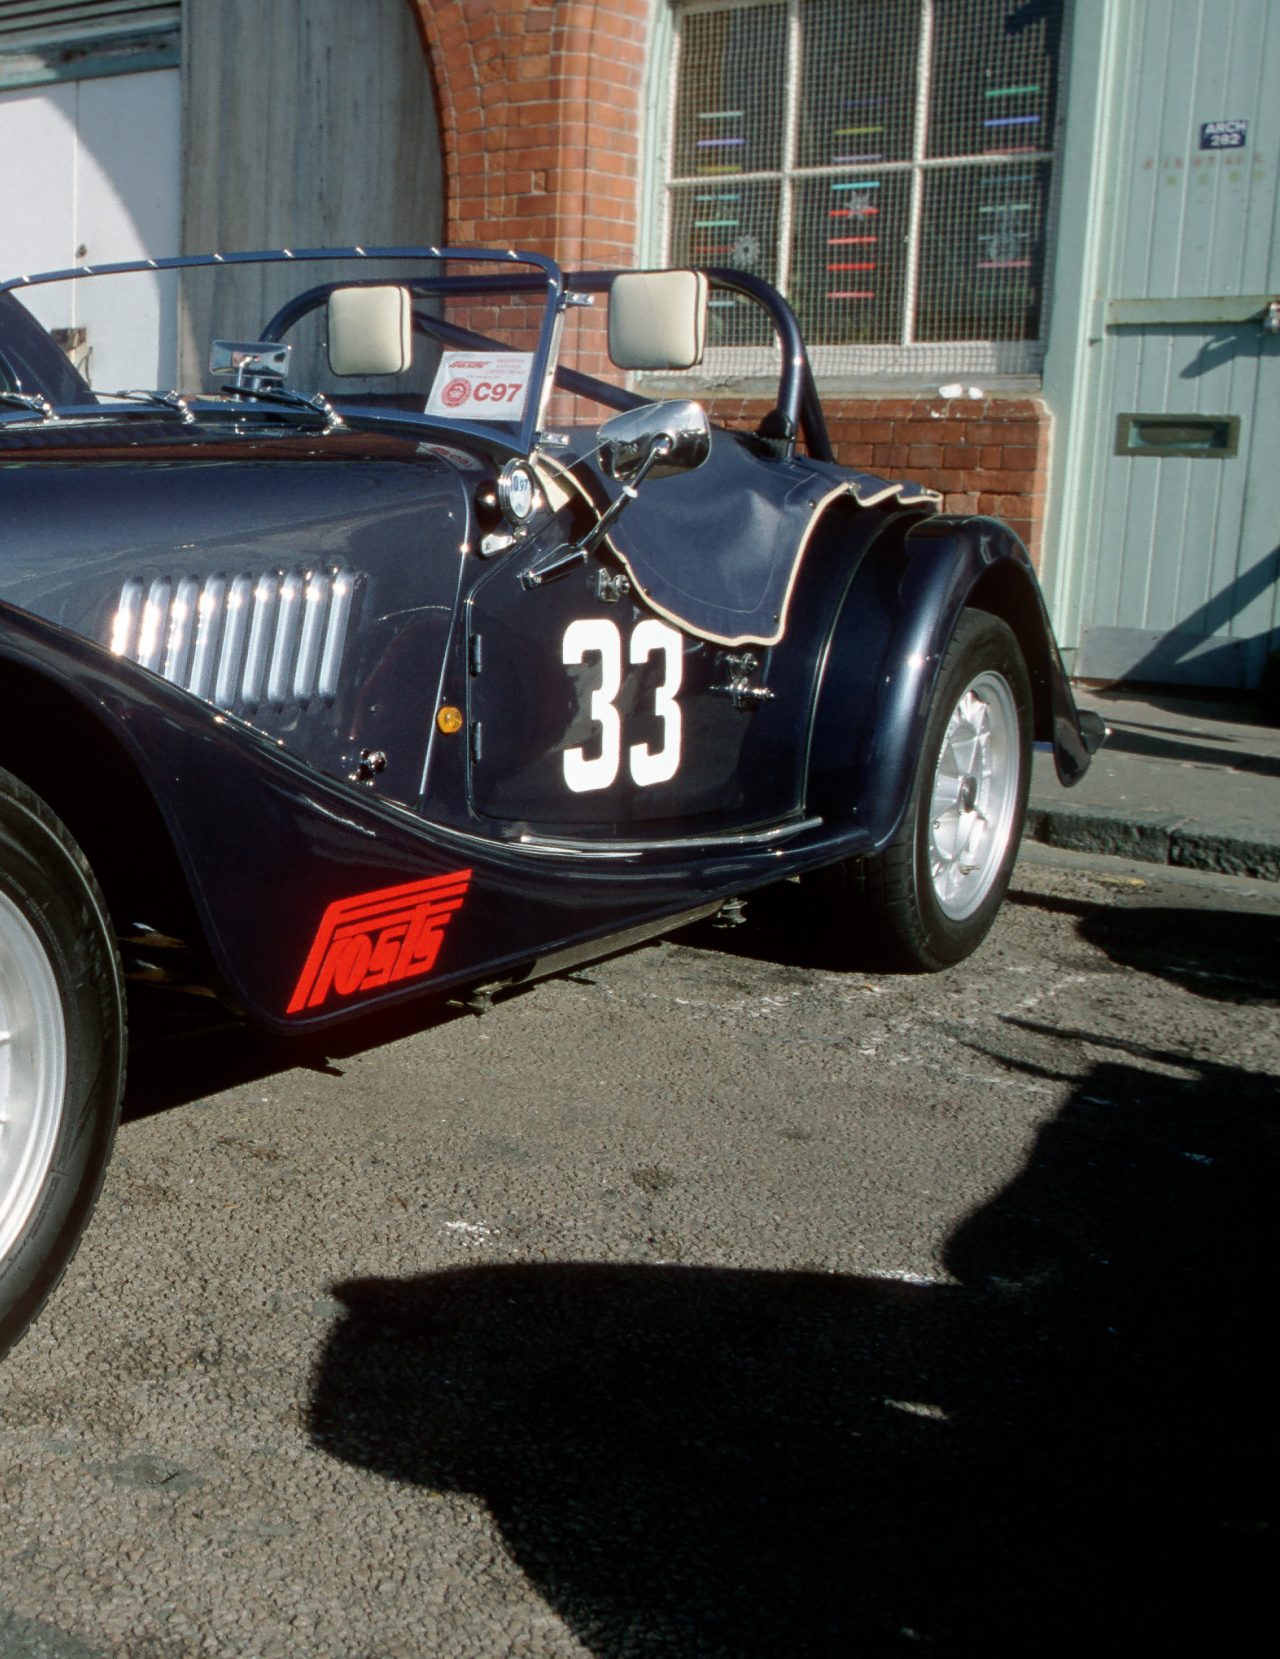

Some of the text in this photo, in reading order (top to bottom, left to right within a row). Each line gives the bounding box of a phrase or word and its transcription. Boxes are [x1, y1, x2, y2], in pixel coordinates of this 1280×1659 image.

[1204, 121, 1247, 134] ARCH
[473, 382, 523, 402] C97
[562, 619, 683, 792] 33
